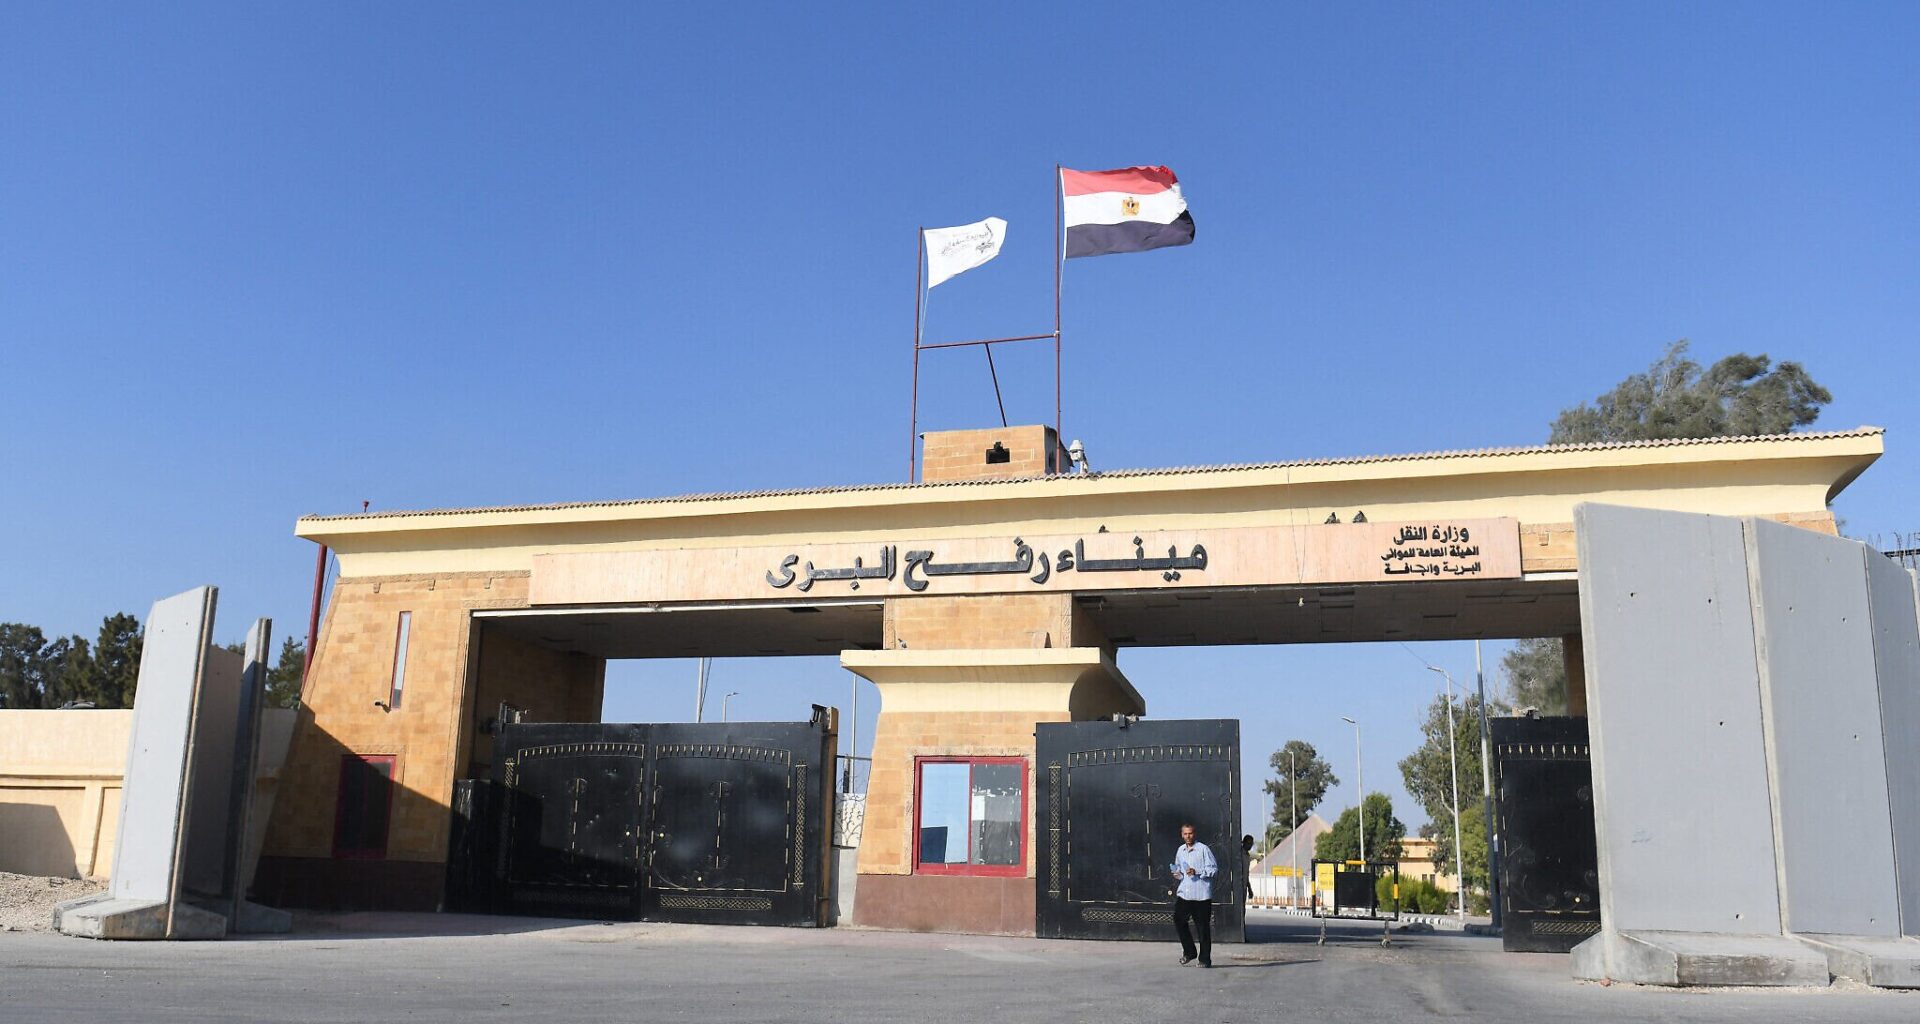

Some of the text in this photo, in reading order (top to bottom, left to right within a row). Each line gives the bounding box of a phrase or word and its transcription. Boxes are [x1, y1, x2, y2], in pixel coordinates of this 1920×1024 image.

[1393, 524, 1470, 545] وزارة النقل
[1056, 536, 1208, 582] ميناء
[1416, 547, 1447, 557] العامة
[1449, 545, 1479, 558] الهيئة
[903, 536, 1050, 592] رفح
[1443, 561, 1481, 575] البرية
